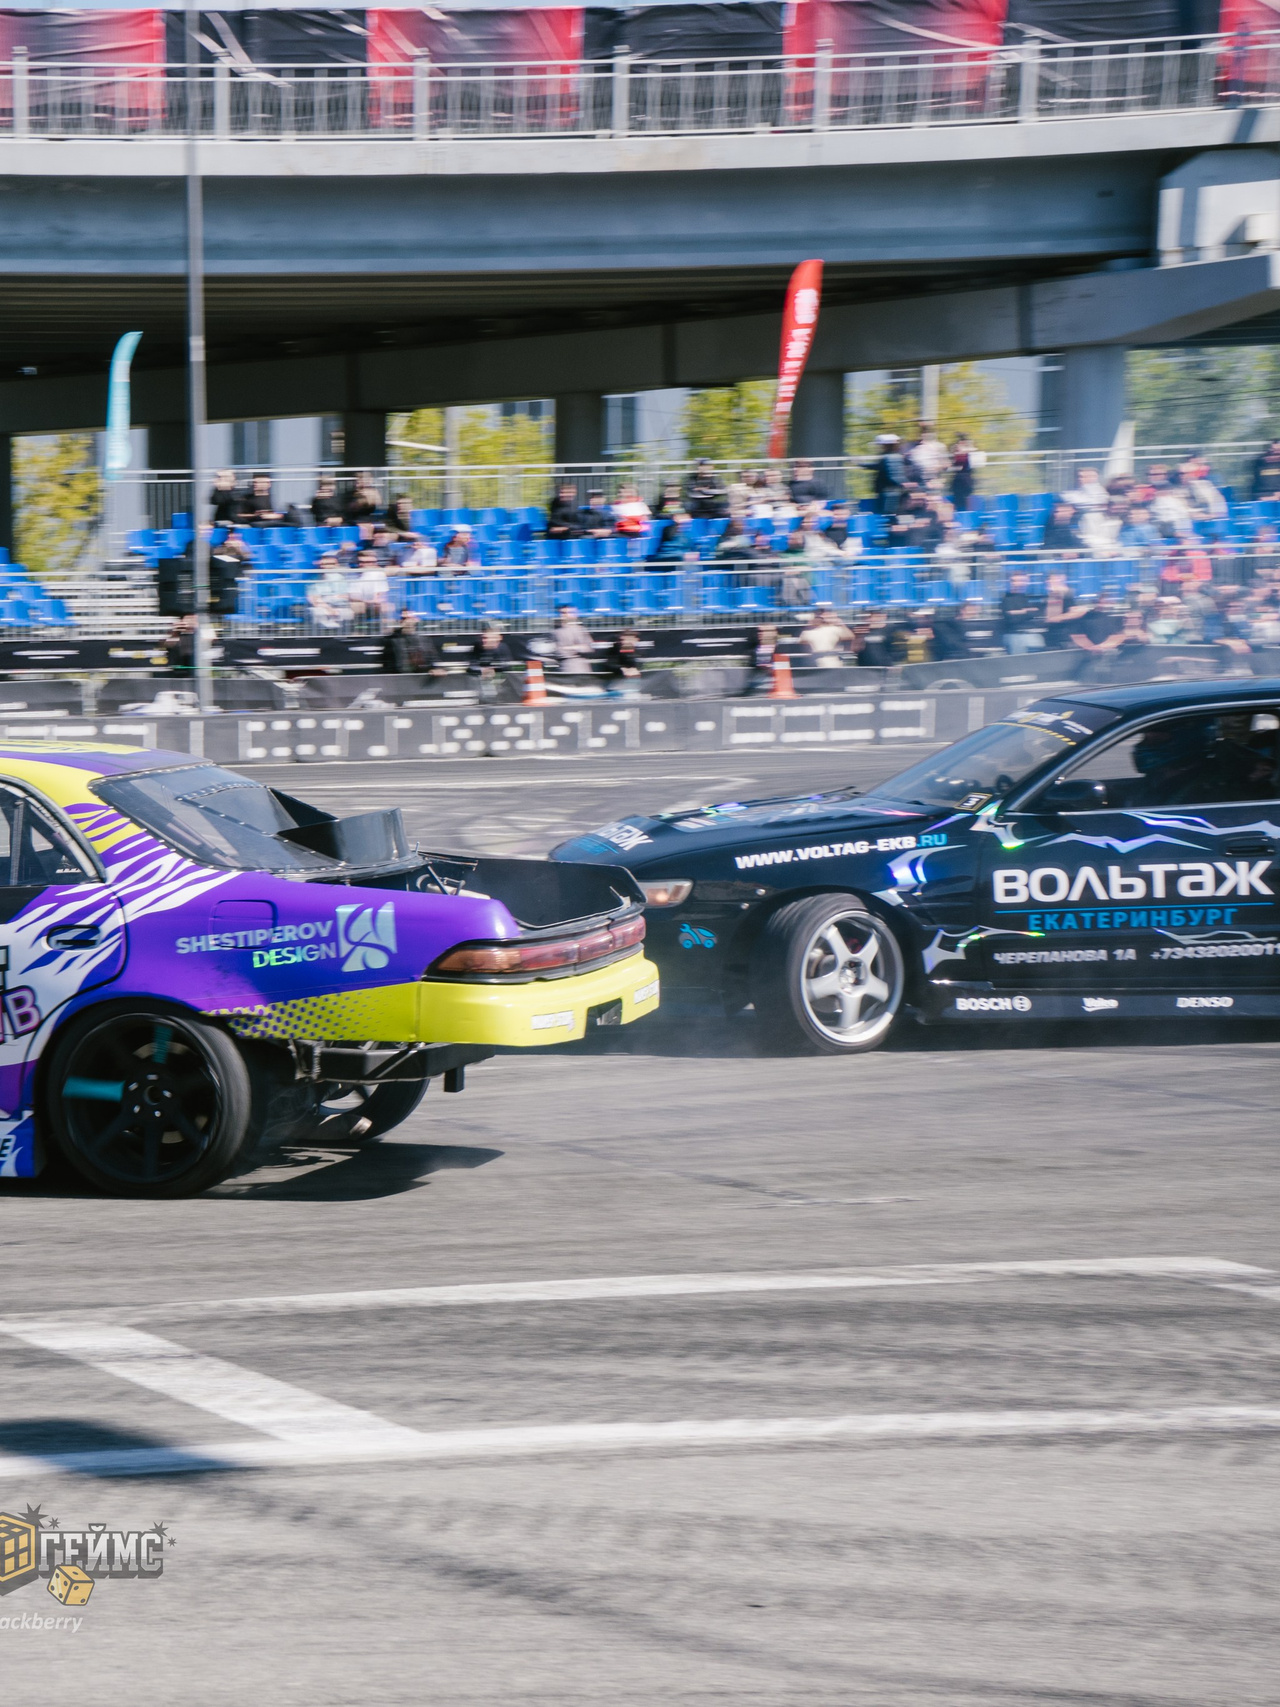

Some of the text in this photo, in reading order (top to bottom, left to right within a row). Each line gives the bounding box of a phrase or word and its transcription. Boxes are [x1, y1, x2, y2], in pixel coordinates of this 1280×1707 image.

[734, 833, 948, 869] WWW.VOLTAG-EKB.RU
[1028, 908, 1238, 931] ЕКАТЕРИНБУРГ
[175, 920, 333, 954] SHESTIPEROV
[252, 942, 336, 968] DESIGN
[993, 949, 1108, 964] ЧЕРЕПАНОВА
[956, 997, 1013, 1010] BOSCH
[1176, 997, 1234, 1008] DENSO
